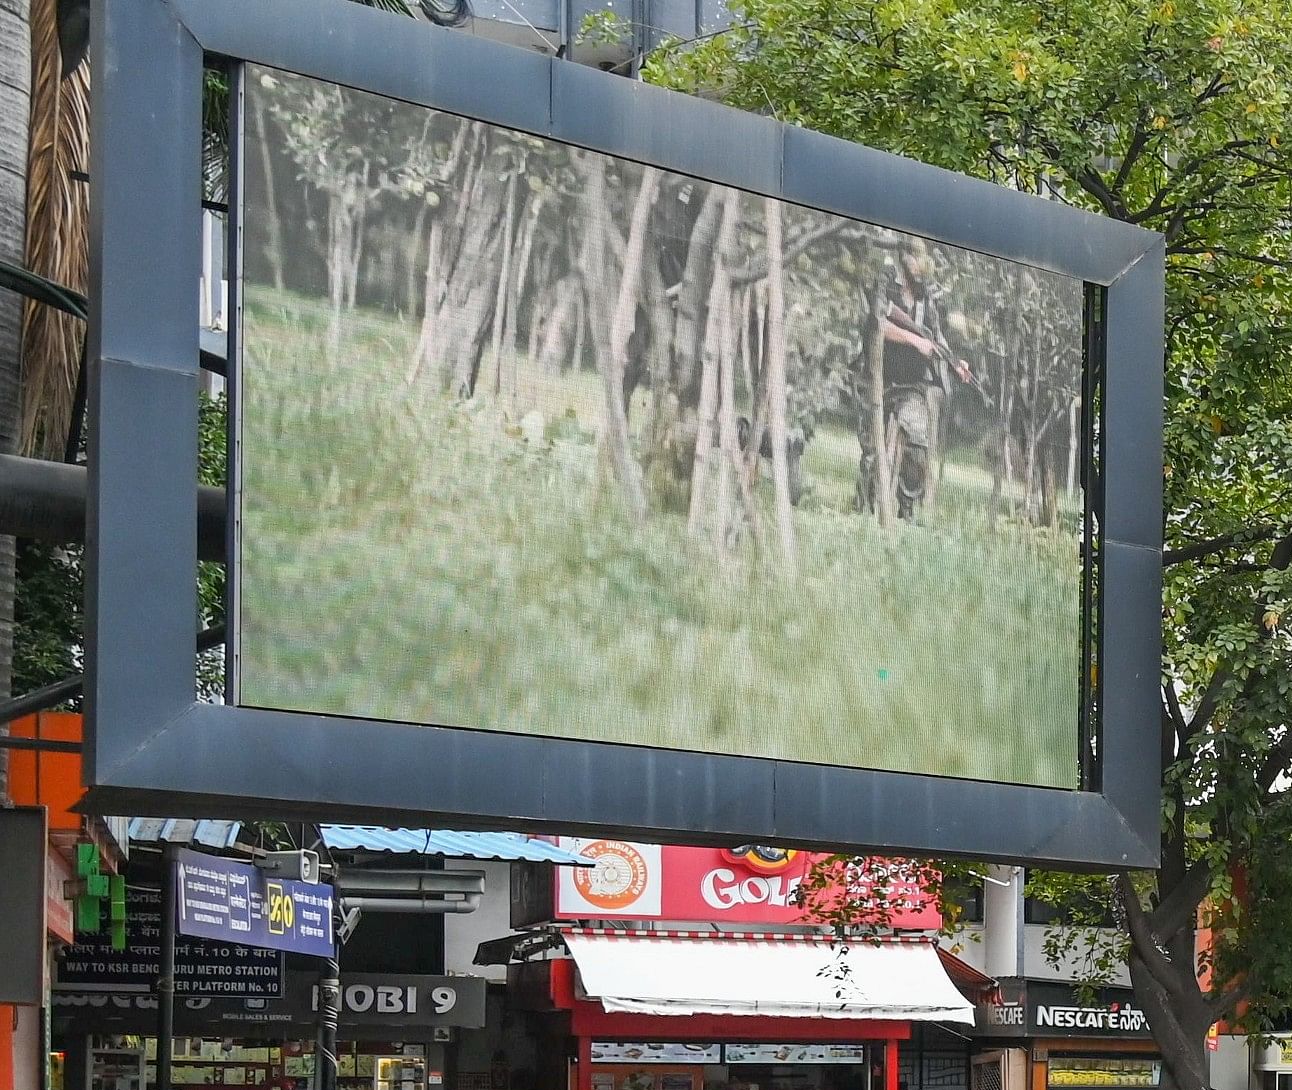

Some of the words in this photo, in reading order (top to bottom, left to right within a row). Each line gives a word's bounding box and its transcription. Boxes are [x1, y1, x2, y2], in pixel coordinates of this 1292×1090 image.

[67, 962, 88, 972] WAY
[93, 963, 104, 972] TO
[108, 963, 129, 973] KSR
[132, 964, 194, 974] BENGURU
[197, 965, 232, 975] METRO
[234, 966, 277, 977] STATION
[193, 981, 245, 992] PLATFORM
[249, 982, 264, 992] No.
[267, 982, 278, 992] 10
[432, 986, 457, 1013] 9
